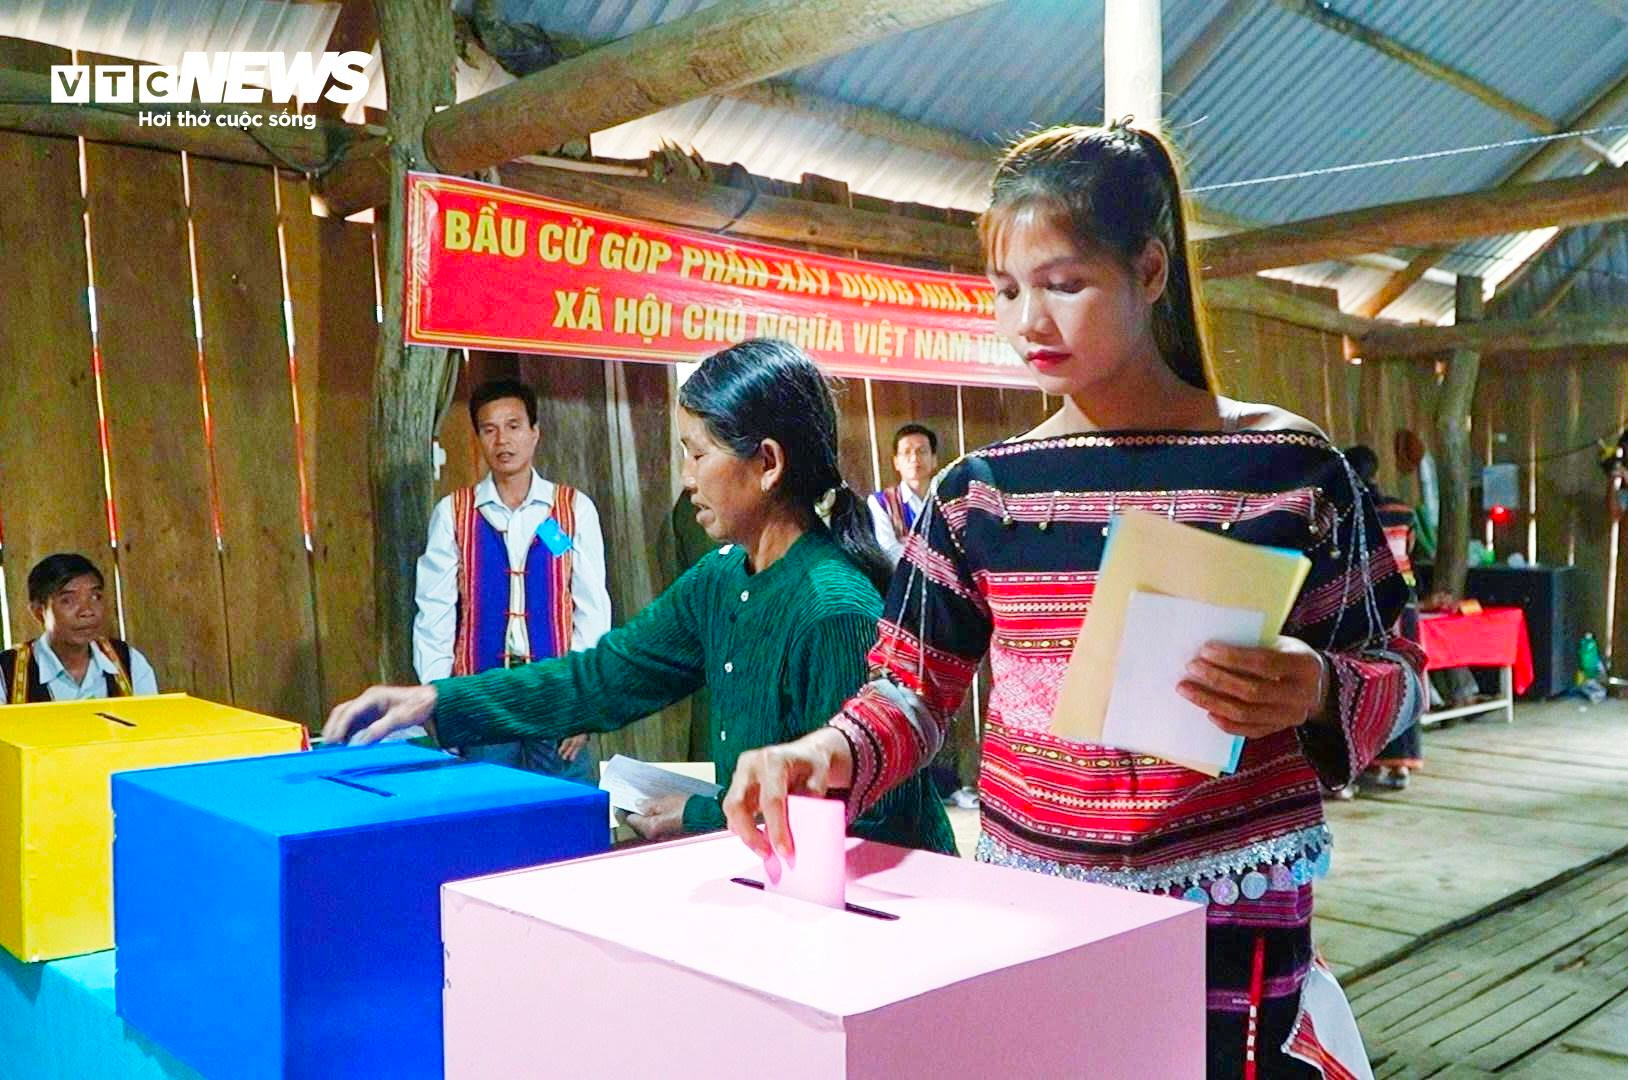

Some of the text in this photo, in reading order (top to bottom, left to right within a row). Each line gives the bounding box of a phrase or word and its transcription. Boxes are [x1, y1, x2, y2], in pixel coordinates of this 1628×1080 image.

[444, 202, 526, 257] BẦU
[538, 217, 595, 266] CỬ
[552, 287, 603, 333] XÃ
[613, 293, 672, 344] HỘI
[682, 299, 746, 344] CHỦ
[755, 311, 844, 353] NGHĨA
[853, 319, 908, 363] VIỆT
[913, 327, 972, 363] NAM
